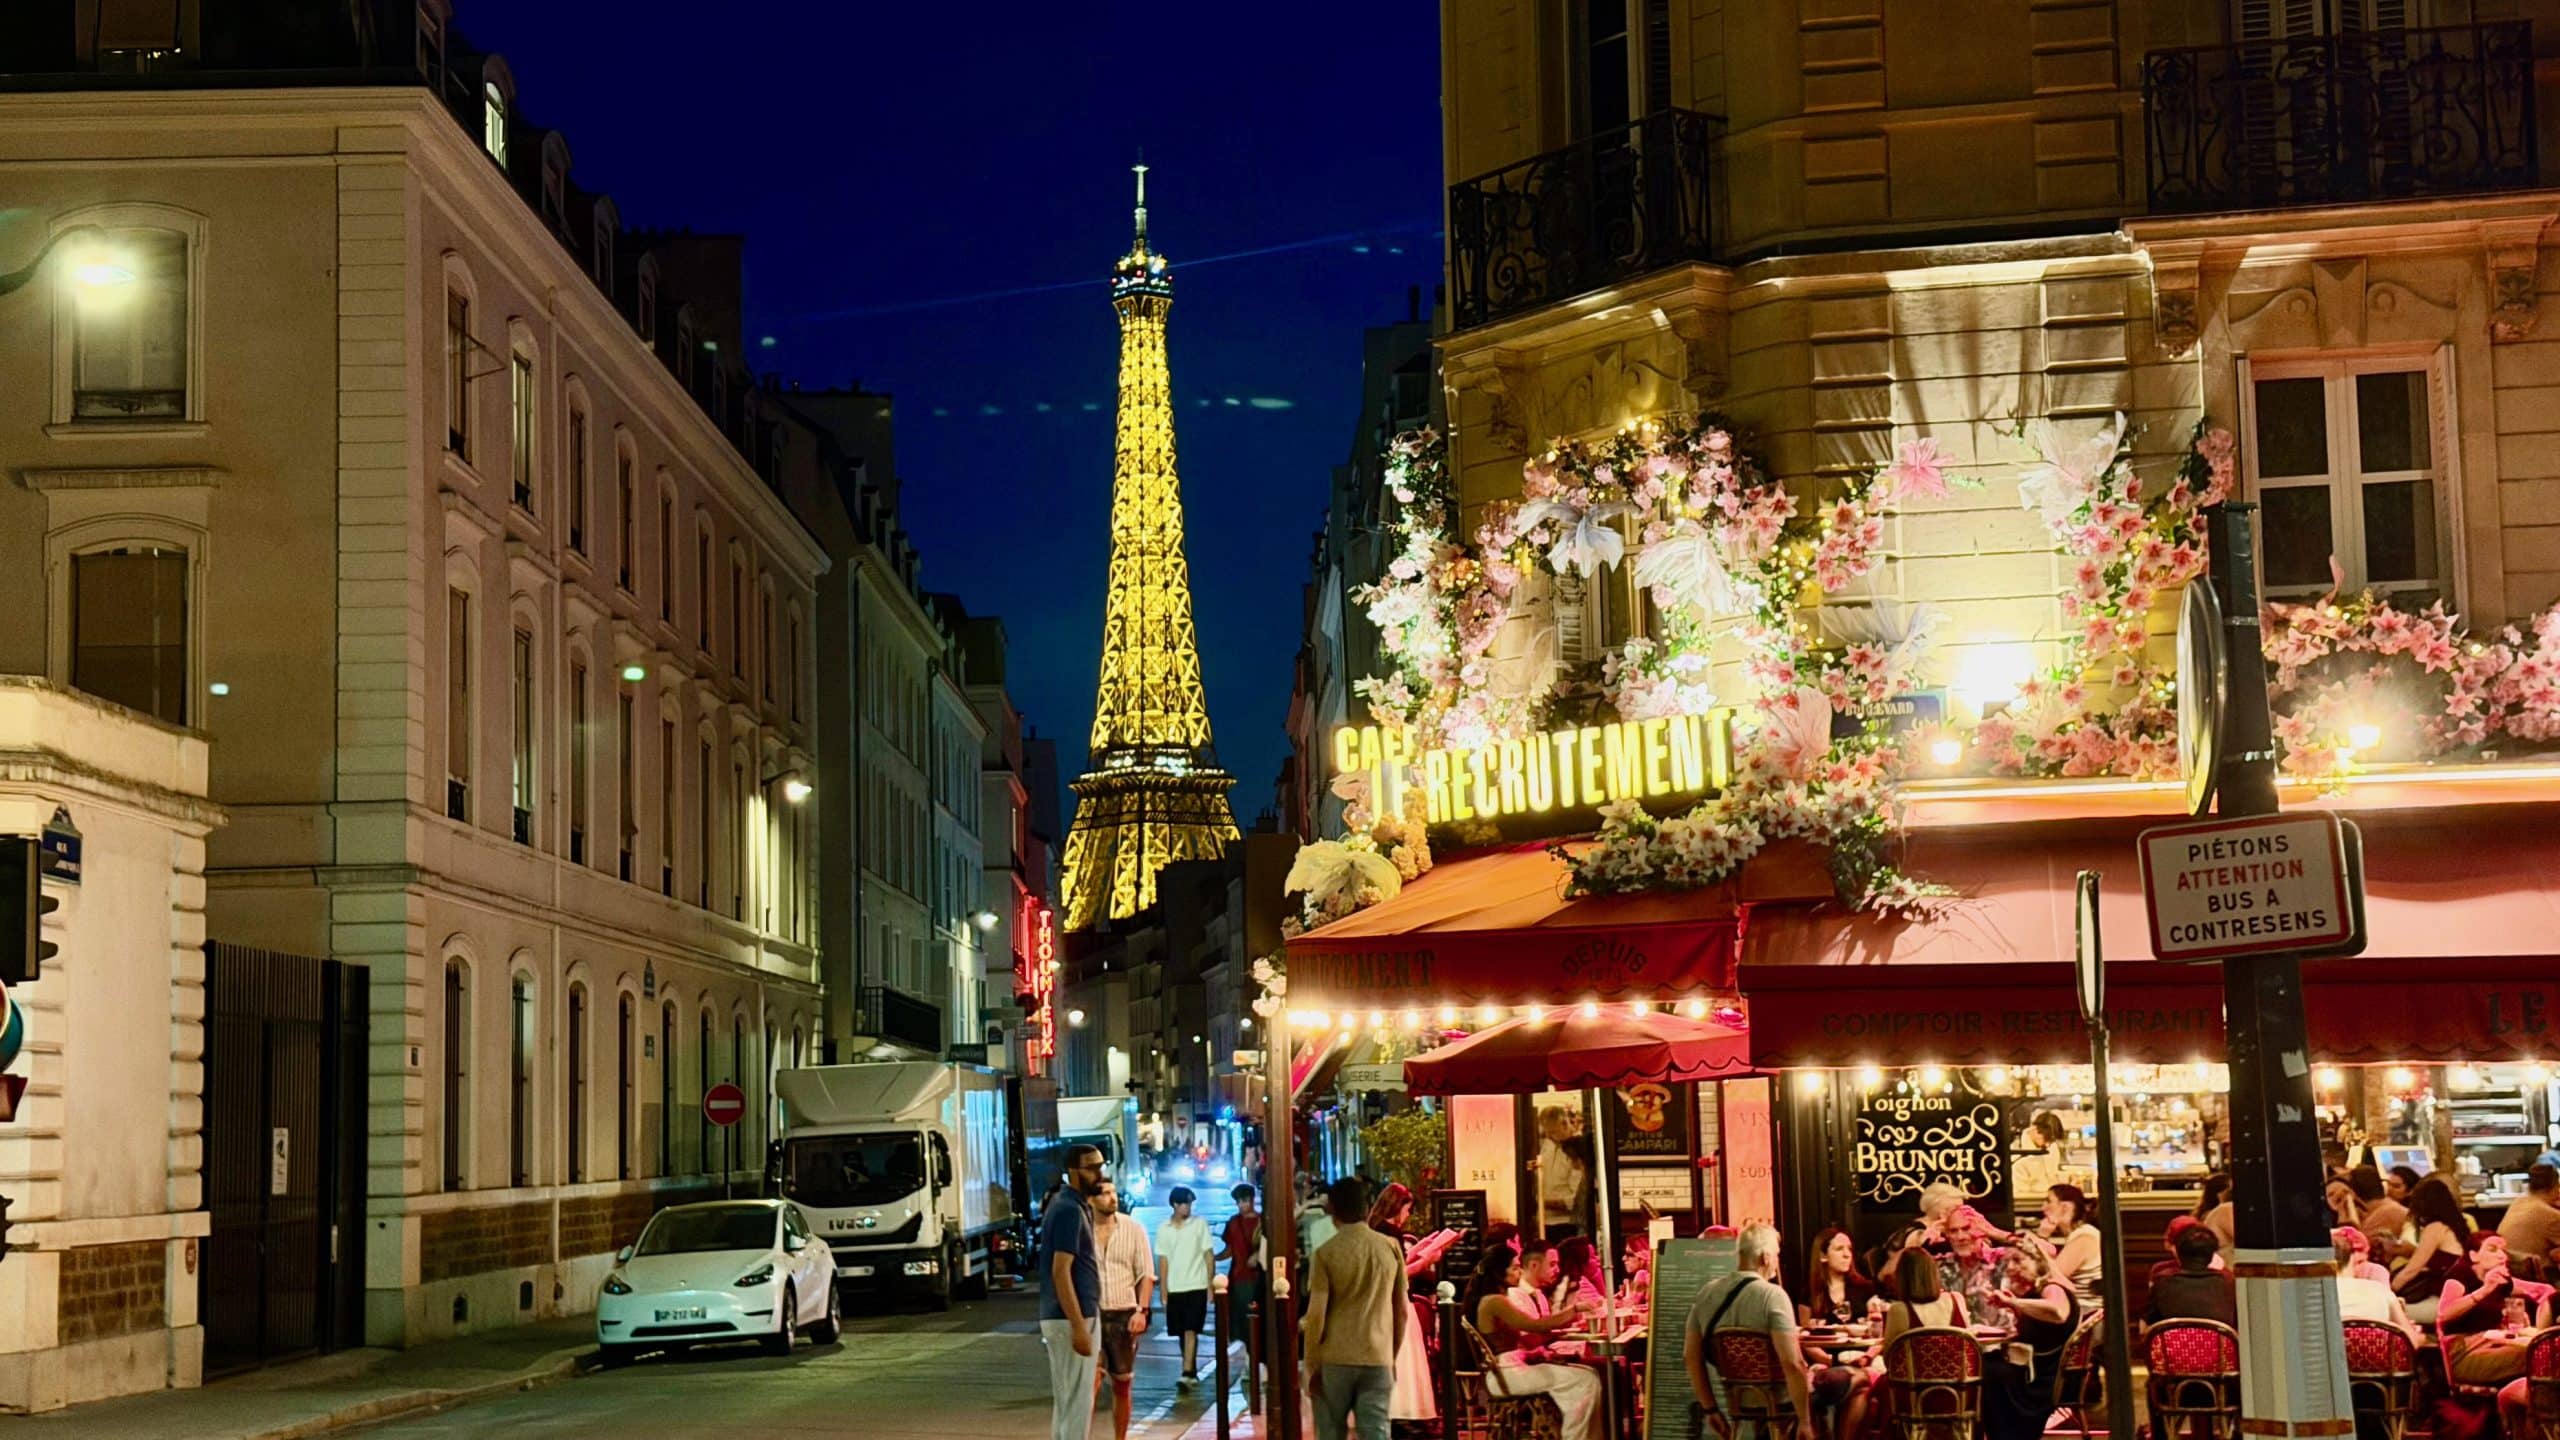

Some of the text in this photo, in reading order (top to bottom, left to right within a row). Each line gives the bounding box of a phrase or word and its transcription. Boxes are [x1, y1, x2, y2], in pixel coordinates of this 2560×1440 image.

[1425, 707, 1736, 825] RECRUTEMENT
[2188, 834, 2290, 863] PIÉTONS
[2176, 858, 2305, 891] ATTENTION
[2208, 887, 2281, 913] BUS A
[2169, 909, 2328, 944] CONTRESENS
[1561, 936, 1649, 977] DEPUIS
[1039, 910, 1054, 1056] THOUMIEUX
[1822, 1007, 2213, 1038] COMPTOIR RESTURANT
[2487, 991, 2547, 1034] LE
[1856, 1142, 1976, 1173] BRUNCH
